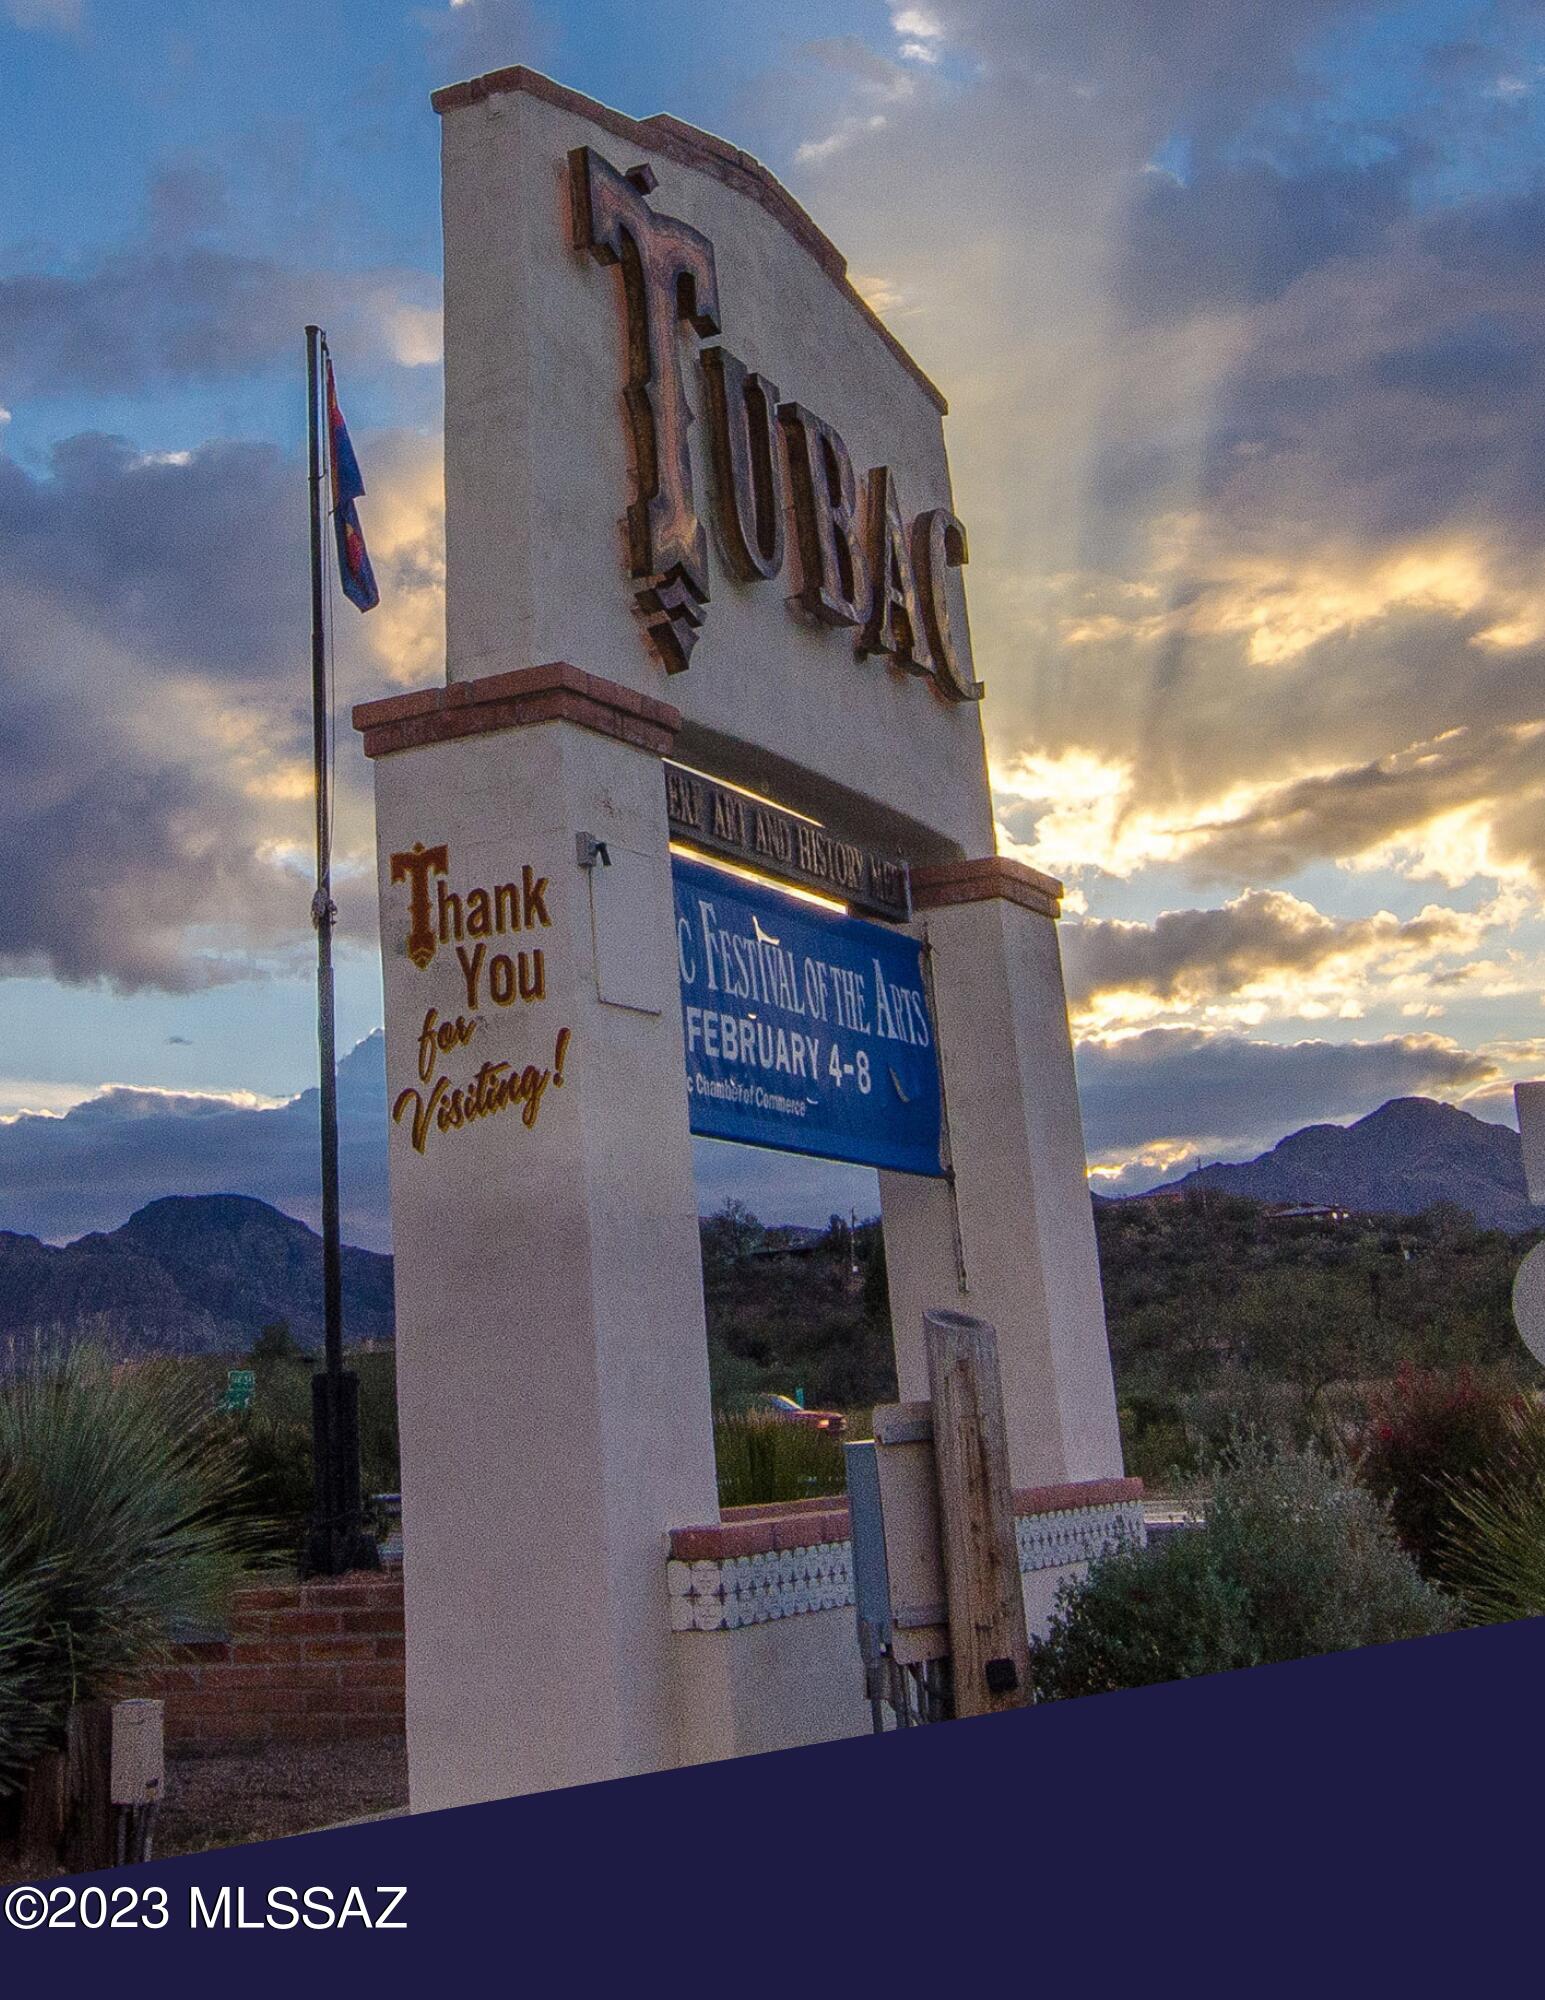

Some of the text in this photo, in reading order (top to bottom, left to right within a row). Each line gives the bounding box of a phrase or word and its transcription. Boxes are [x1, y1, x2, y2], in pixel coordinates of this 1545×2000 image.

[567, 145, 985, 700] TUBAC
[755, 805, 792, 864] AND
[798, 823, 864, 889] HISTORY
[389, 842, 552, 973] Thank
[456, 942, 547, 1011] You
[698, 900, 806, 1016] FESTIVAL
[803, 956, 829, 1022] OF
[829, 966, 871, 1036] THE
[872, 957, 930, 1048] ARTS
[418, 1007, 478, 1084] for
[686, 1005, 872, 1095] FEBRUARY 4-8
[392, 1026, 573, 1156] Visiting!
[695, 1071, 744, 1103] Chamber
[755, 1086, 808, 1118] Commerce
